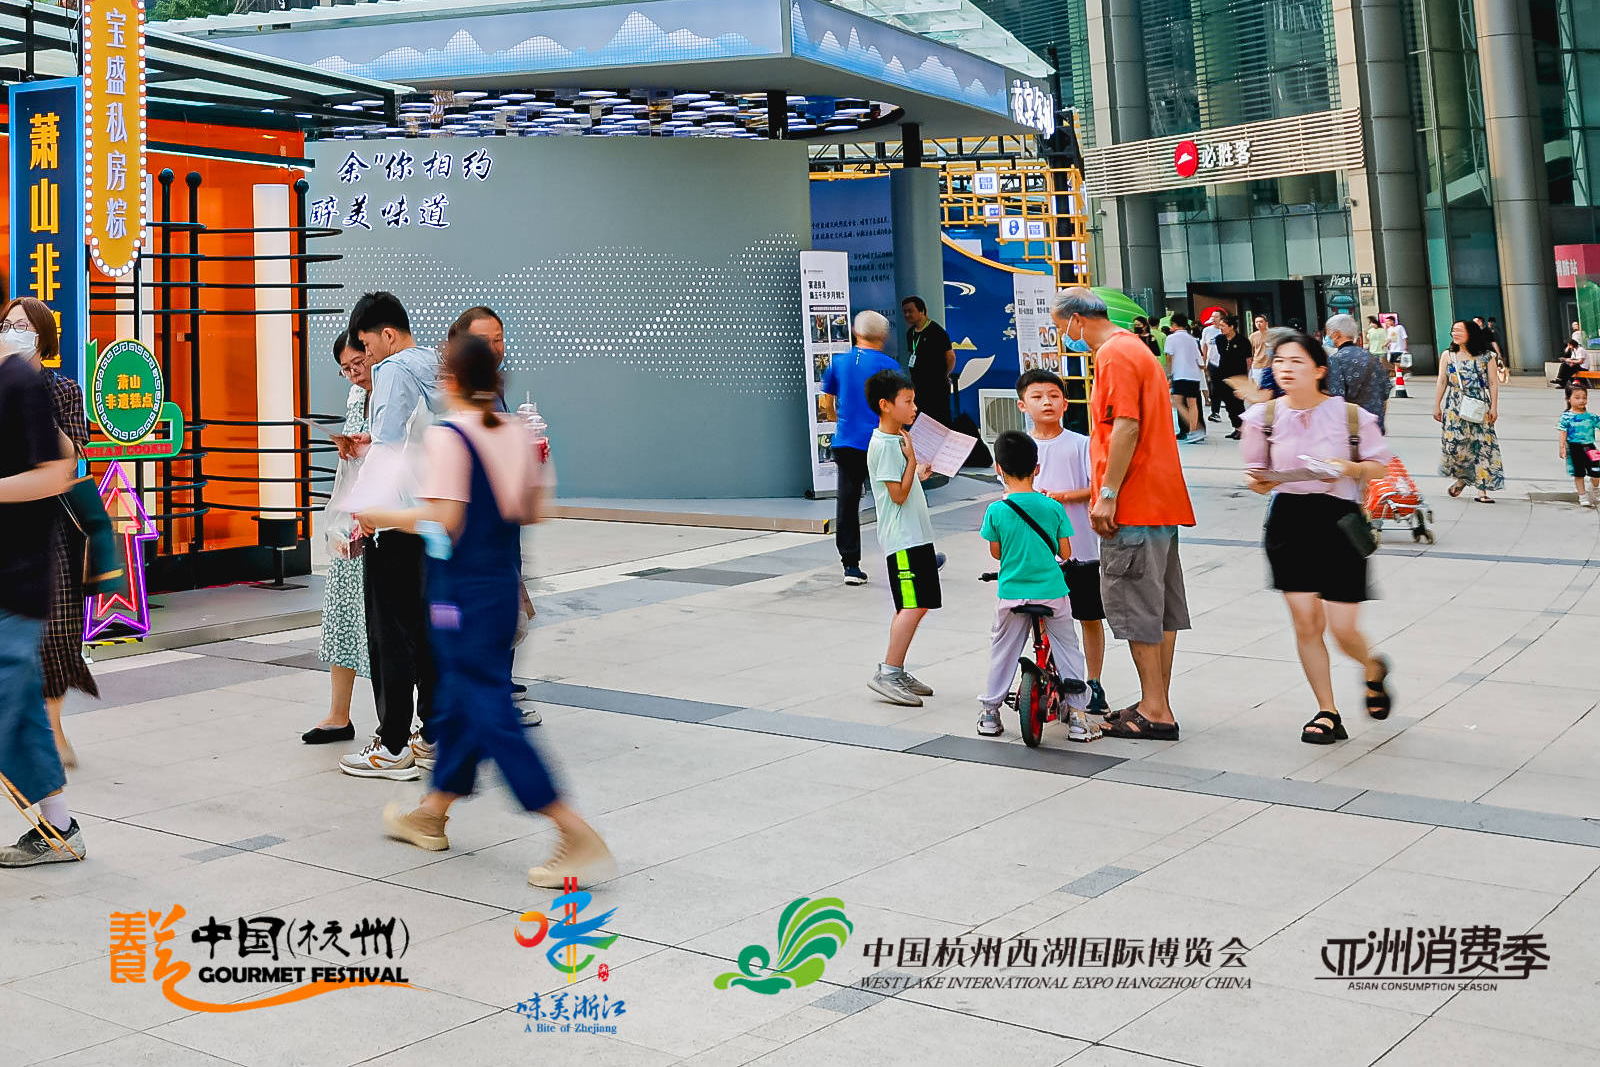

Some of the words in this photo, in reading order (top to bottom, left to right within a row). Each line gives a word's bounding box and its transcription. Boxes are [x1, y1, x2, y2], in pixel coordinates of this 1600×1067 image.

[105, 7, 128, 240] 宝盛私房粽
[1200, 140, 1251, 168] 必胜客
[309, 192, 451, 231] 醉美味道
[117, 374, 142, 390] 萧山
[105, 392, 153, 410] 非遗糕点
